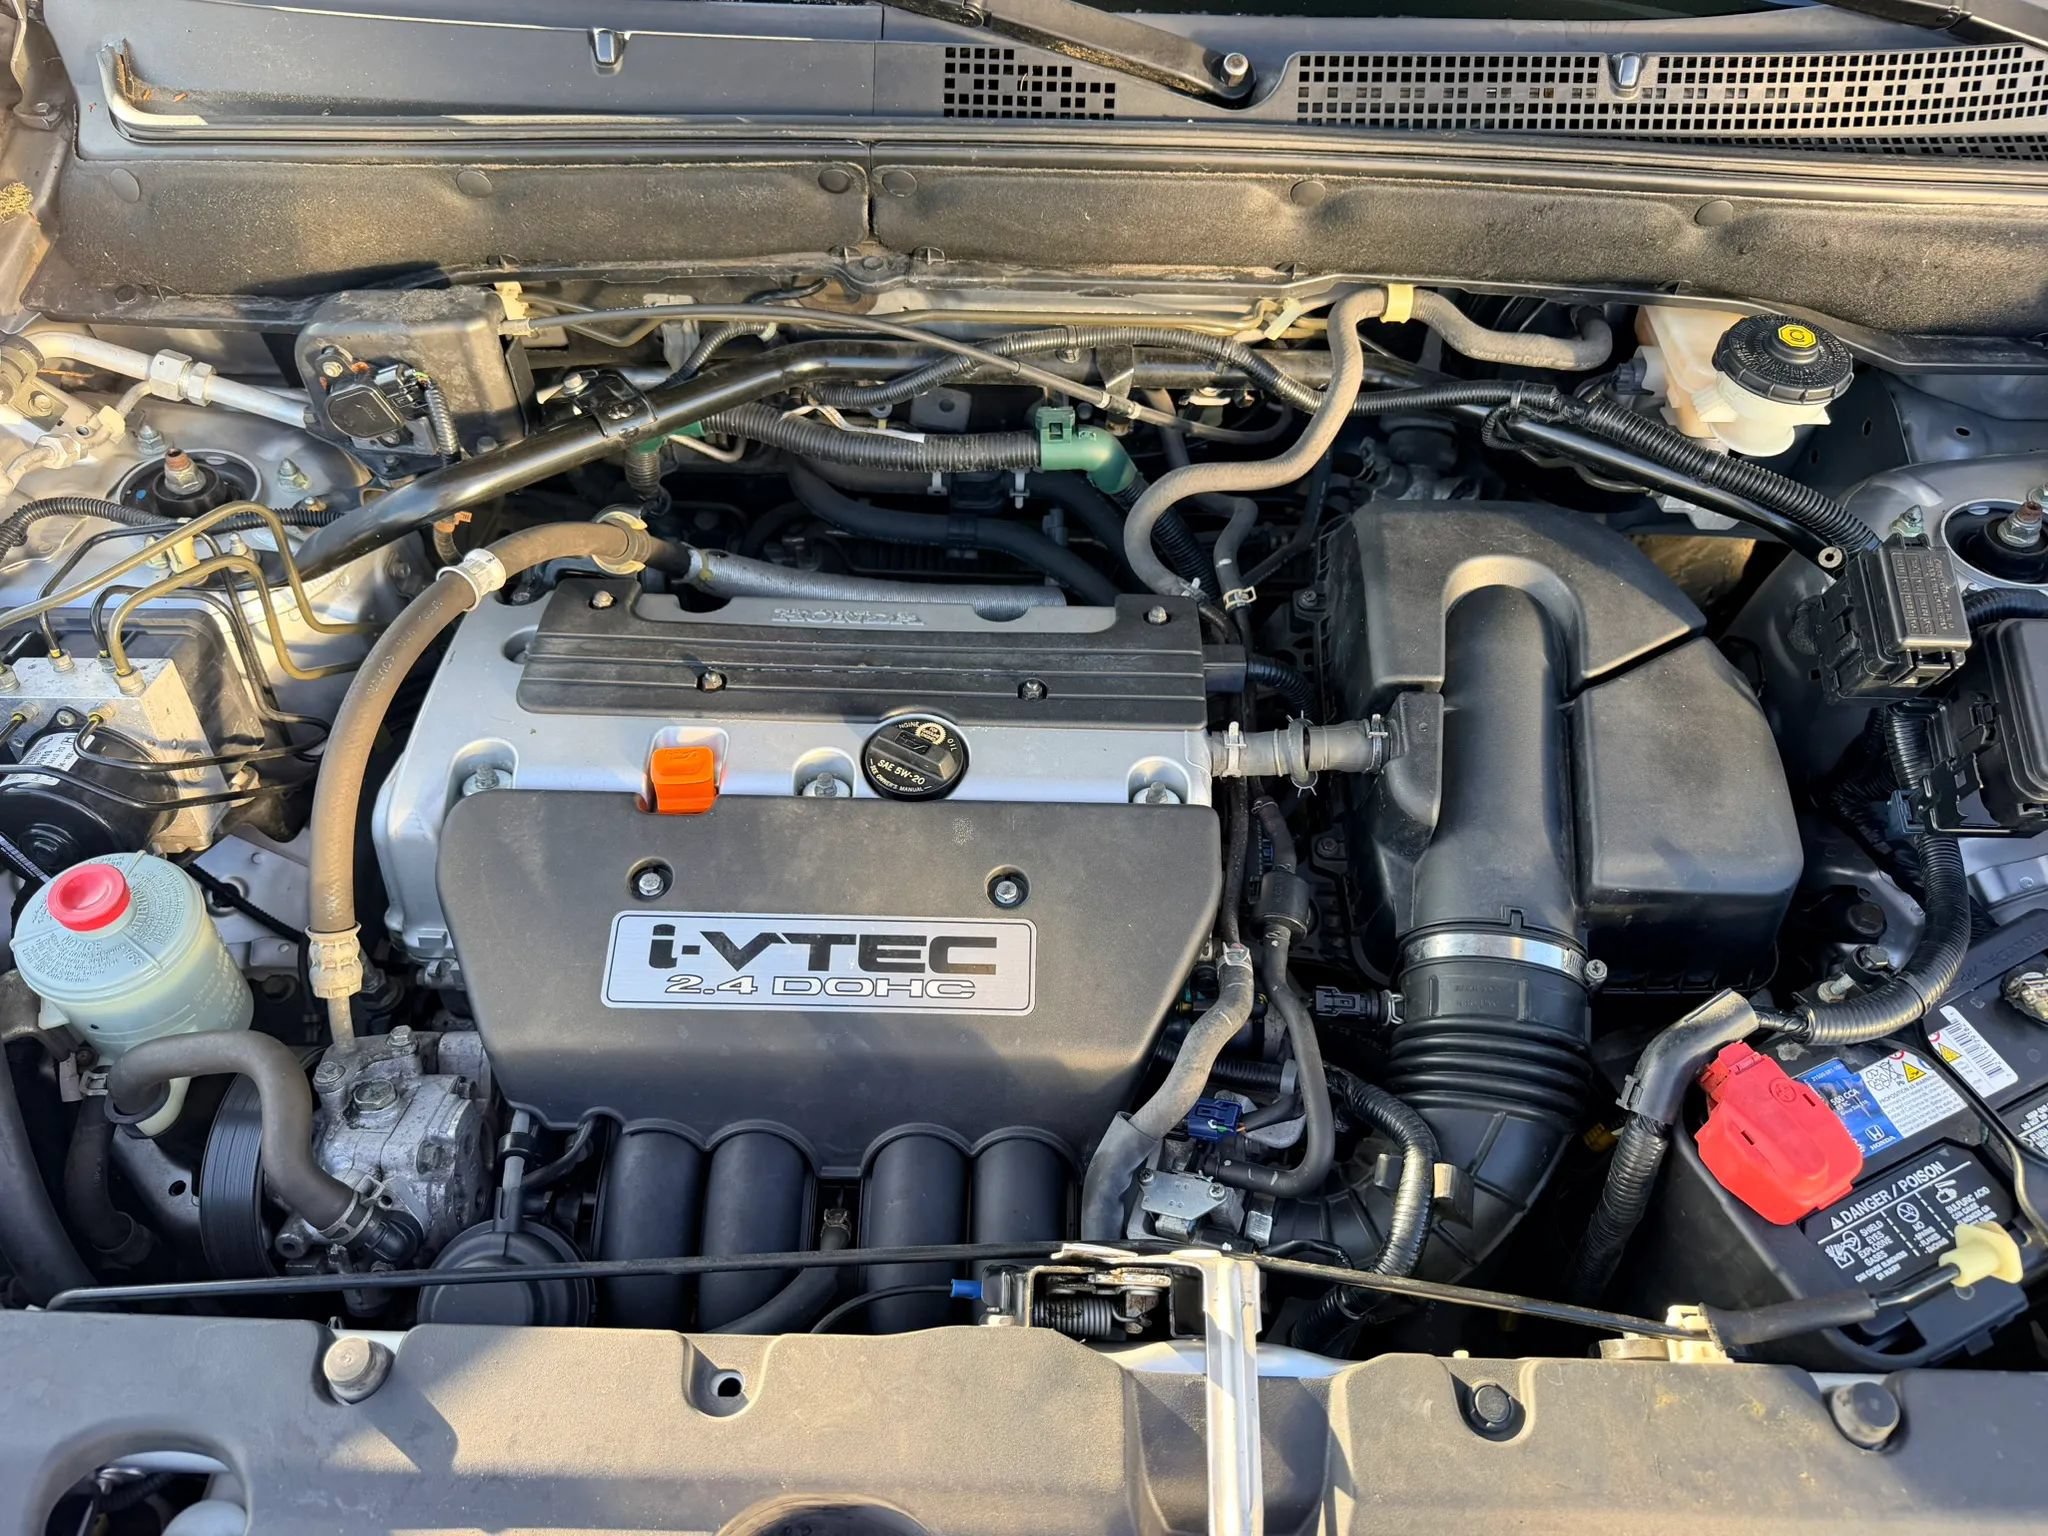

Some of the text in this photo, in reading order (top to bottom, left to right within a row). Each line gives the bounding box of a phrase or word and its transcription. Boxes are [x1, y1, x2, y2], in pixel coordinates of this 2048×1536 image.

[947, 738, 958, 751] OIL
[877, 759, 925, 785] SAE 5W-20
[61, 934, 102, 952] NOTICE
[648, 923, 997, 975] i-VTEC
[665, 974, 976, 999] 2.4 DOHC
[1830, 1088, 1860, 1106] 500 CCA
[1870, 1135, 1896, 1151] HONDA
[1840, 1161, 1946, 1223] DANGER / POISON
[1945, 1186, 1991, 1214] SULFURIC ACID
[1859, 1220, 1884, 1237] SHIELD
[1912, 1221, 1925, 1231] NO
[1857, 1235, 1894, 1259] EXPLOSIVE
[1865, 1231, 1885, 1245] EYES
[1864, 1250, 1888, 1266] GASES
